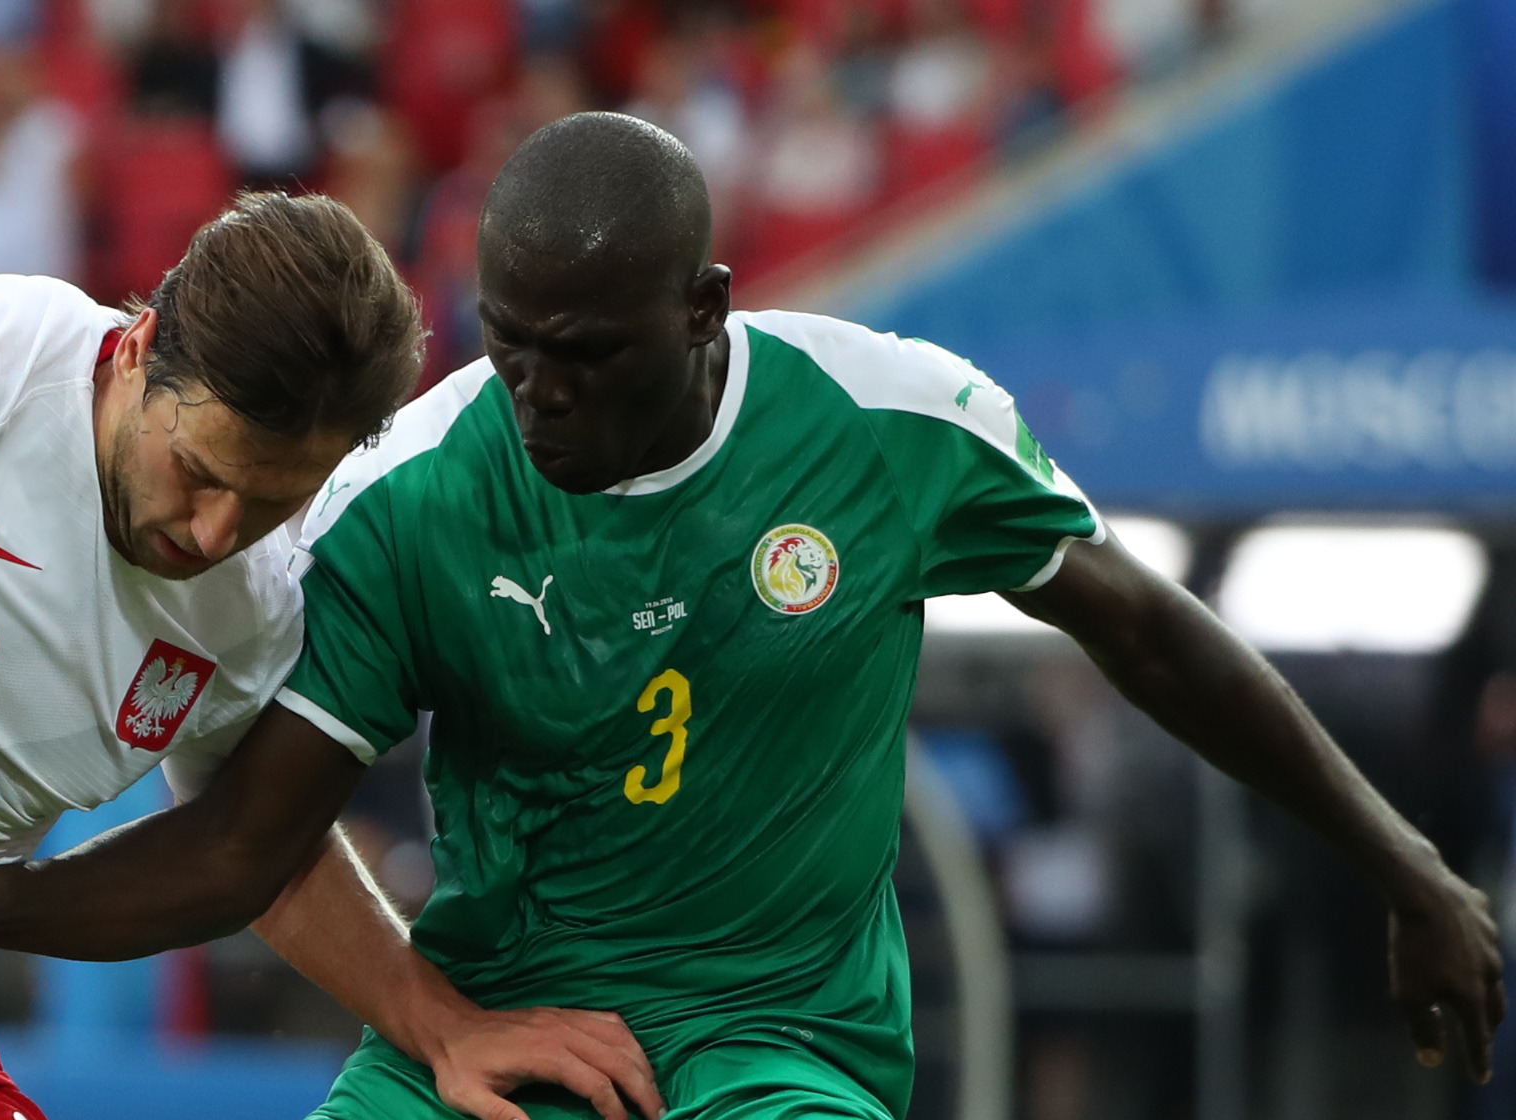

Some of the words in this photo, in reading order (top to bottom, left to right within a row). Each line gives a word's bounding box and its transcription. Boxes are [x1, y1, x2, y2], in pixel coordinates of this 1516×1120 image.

[632, 610, 656, 631] SEN
[667, 601, 688, 622] POL
[623, 668, 692, 804] 3
